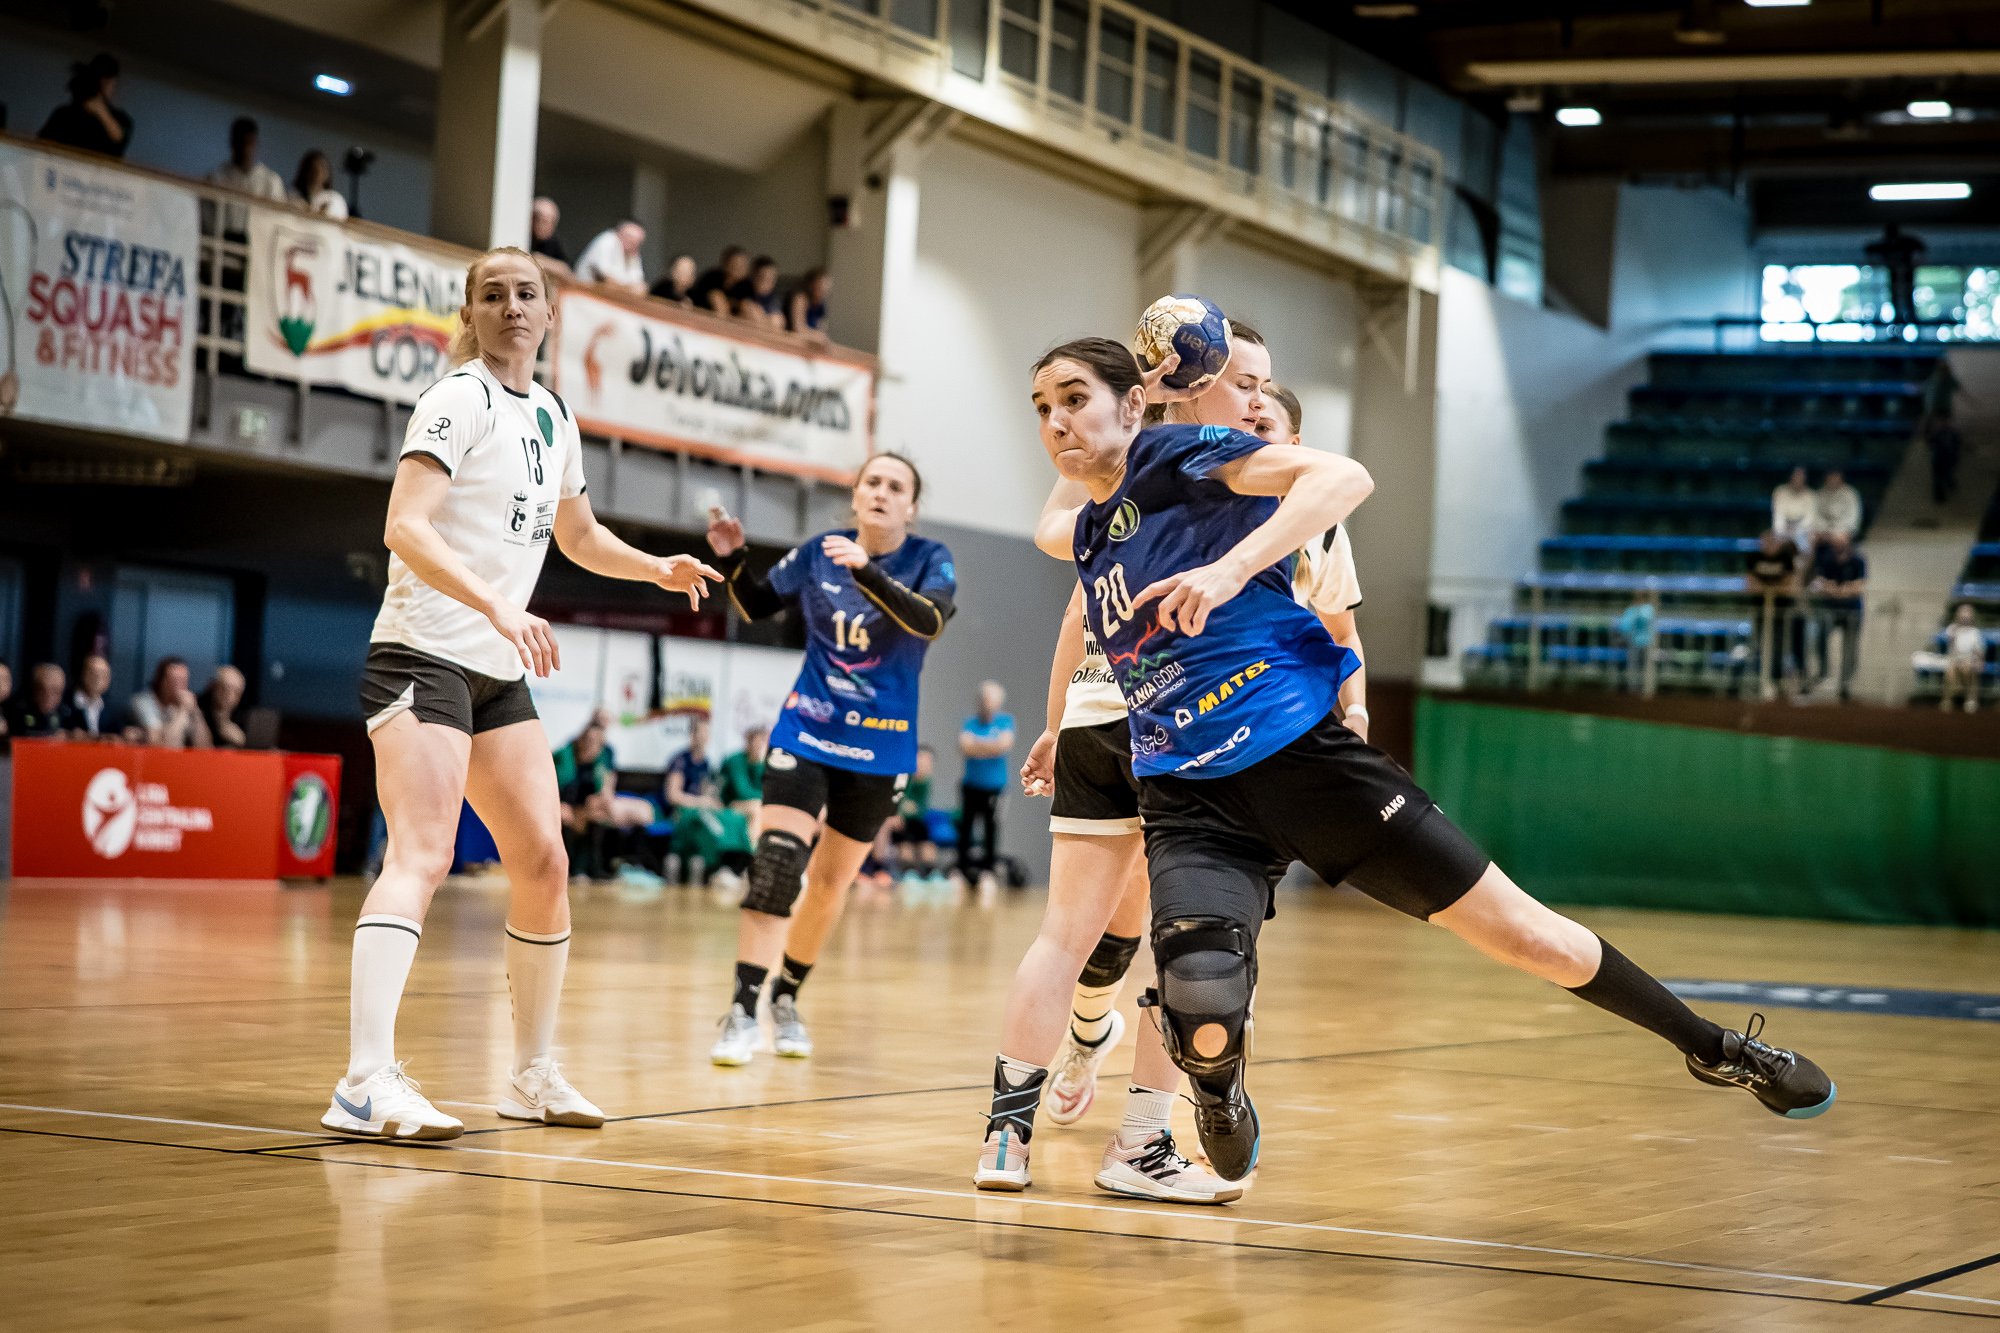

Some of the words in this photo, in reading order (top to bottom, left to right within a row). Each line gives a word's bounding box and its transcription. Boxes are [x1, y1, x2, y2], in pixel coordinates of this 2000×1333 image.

[64, 230, 187, 298] STREFA
[27, 271, 183, 347] SQUASH
[521, 436, 544, 486] 13
[1093, 562, 1135, 639] 20
[831, 609, 871, 652] 14
[1197, 659, 1272, 715] MATEX
[1380, 794, 1406, 822] JAKO
